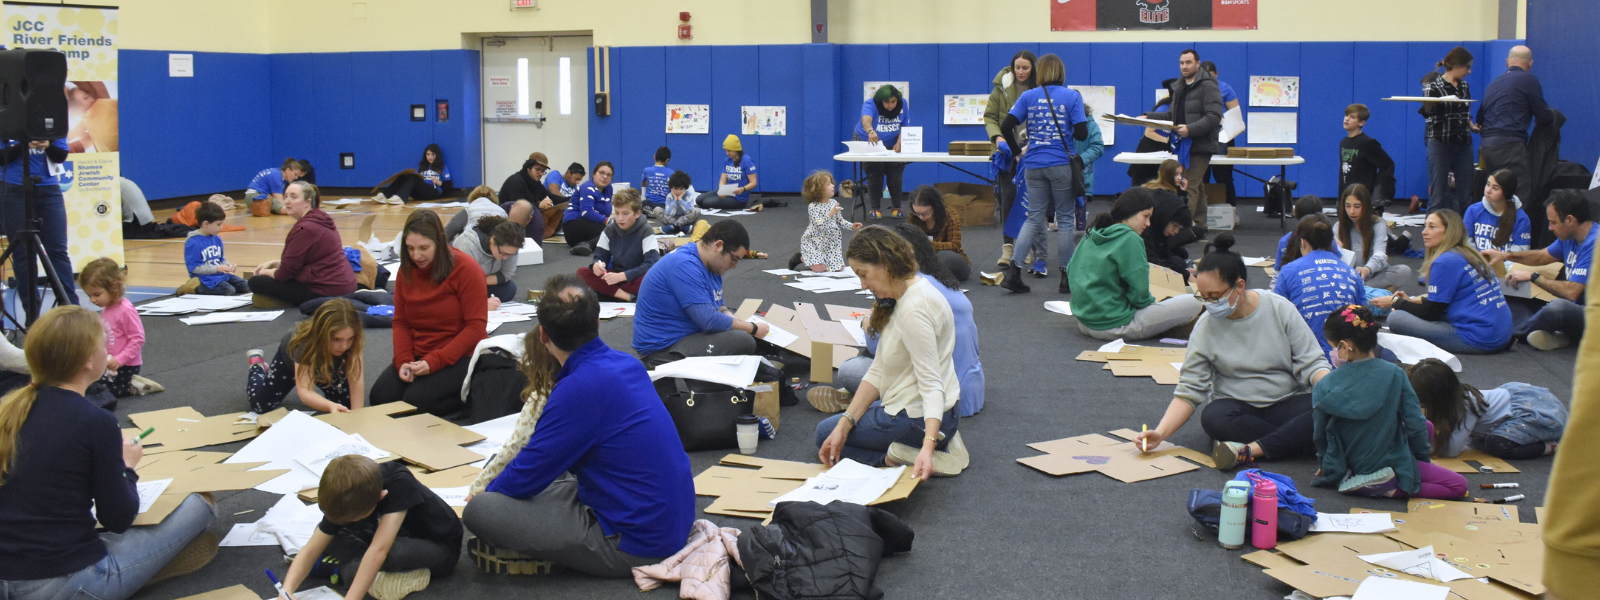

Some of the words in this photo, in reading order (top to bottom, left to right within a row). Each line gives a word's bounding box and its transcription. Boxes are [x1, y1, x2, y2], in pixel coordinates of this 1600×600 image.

[1141, 9, 1169, 22] ELITE
[13, 20, 44, 32] JCC
[13, 34, 53, 45] River
[58, 35, 112, 46] Friends
